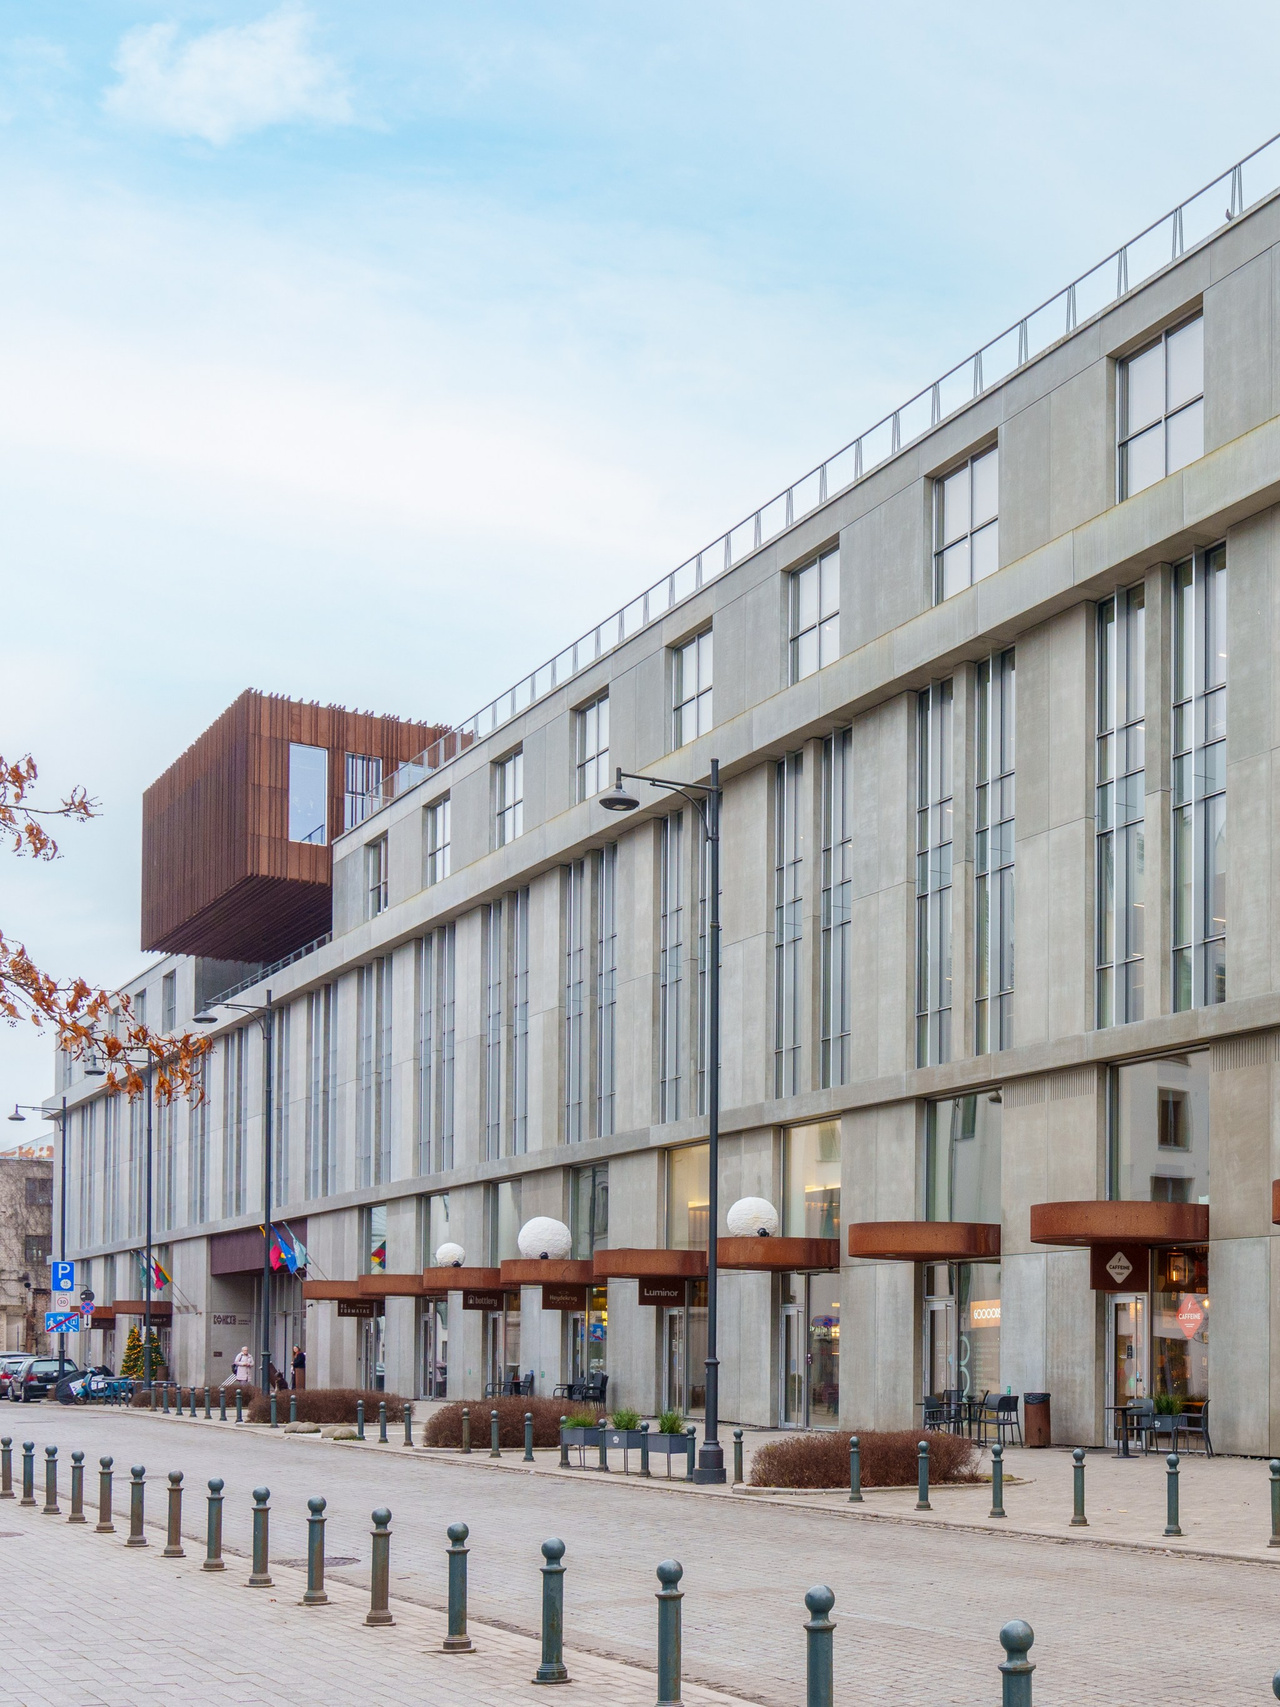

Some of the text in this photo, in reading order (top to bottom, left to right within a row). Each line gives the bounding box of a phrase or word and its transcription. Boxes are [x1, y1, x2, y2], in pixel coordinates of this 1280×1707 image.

[58, 1263, 71, 1279] P
[644, 1288, 679, 1297] Luminor
[1178, 1312, 1201, 1320] CAFFEINE
